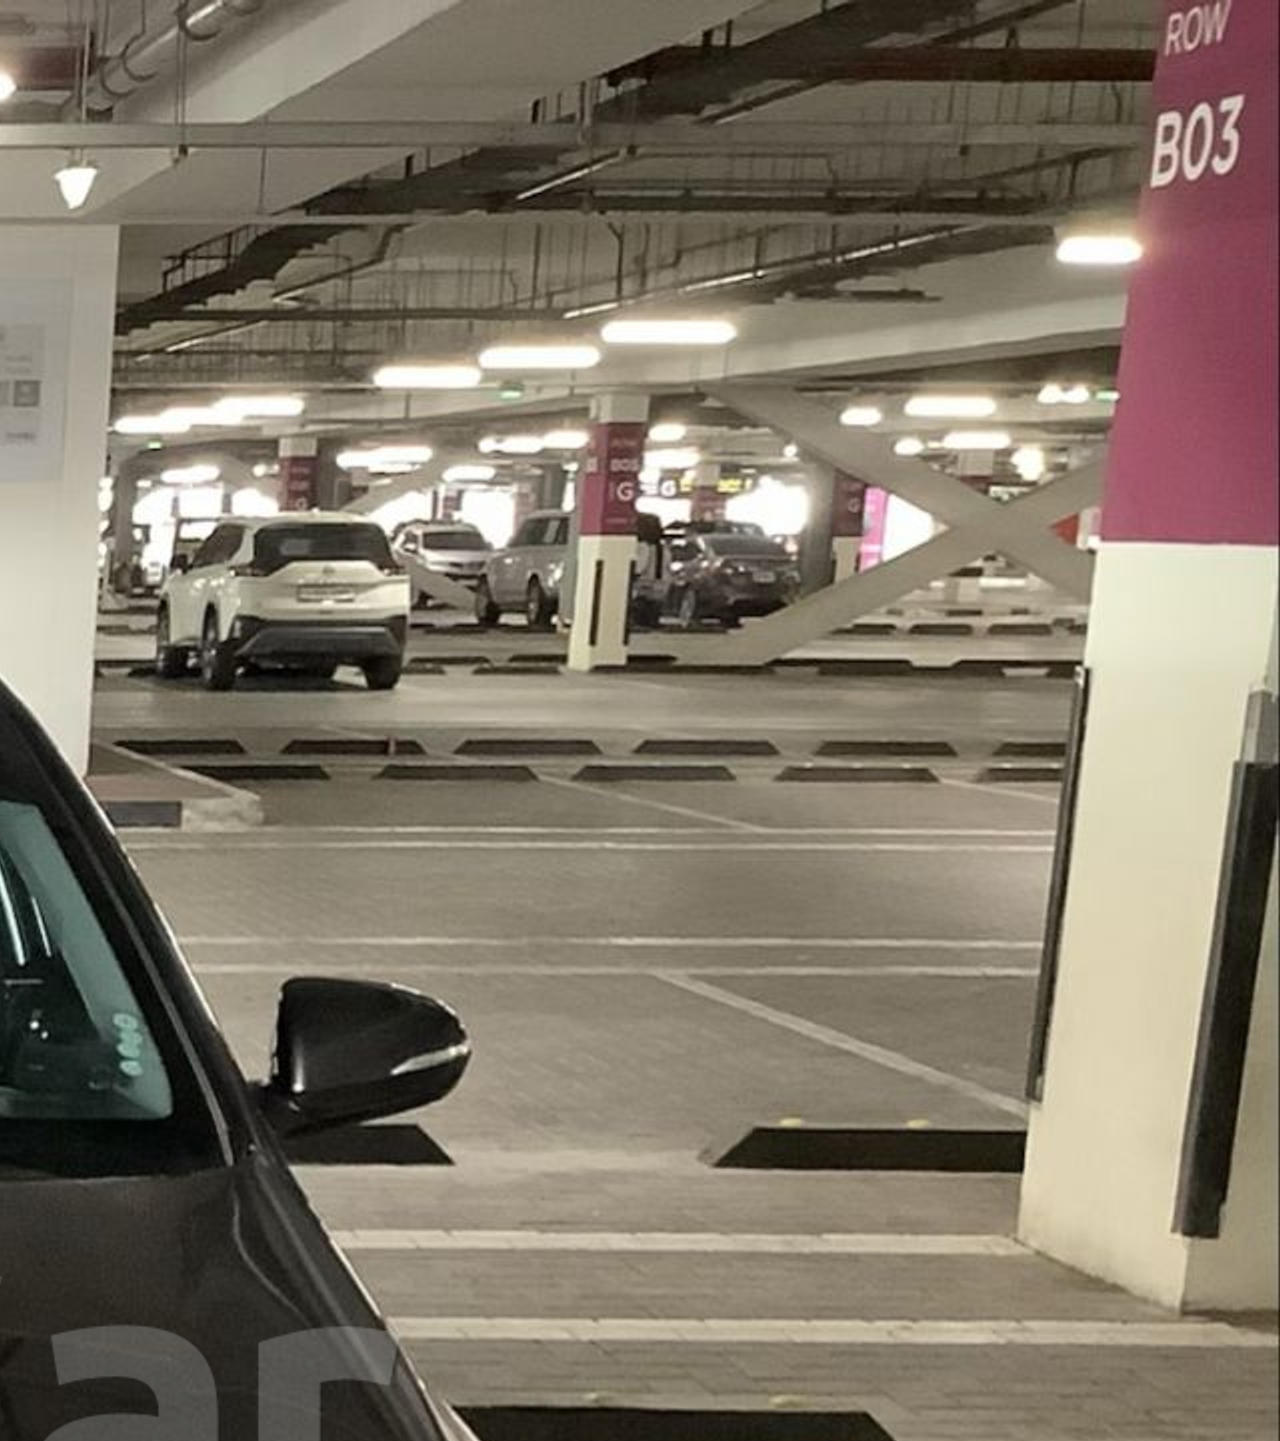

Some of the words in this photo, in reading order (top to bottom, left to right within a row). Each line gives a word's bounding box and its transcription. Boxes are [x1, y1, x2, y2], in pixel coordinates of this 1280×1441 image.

[1165, 0, 1232, 56] ROW
[1151, 94, 1245, 189] B03
[616, 482, 636, 502] G
